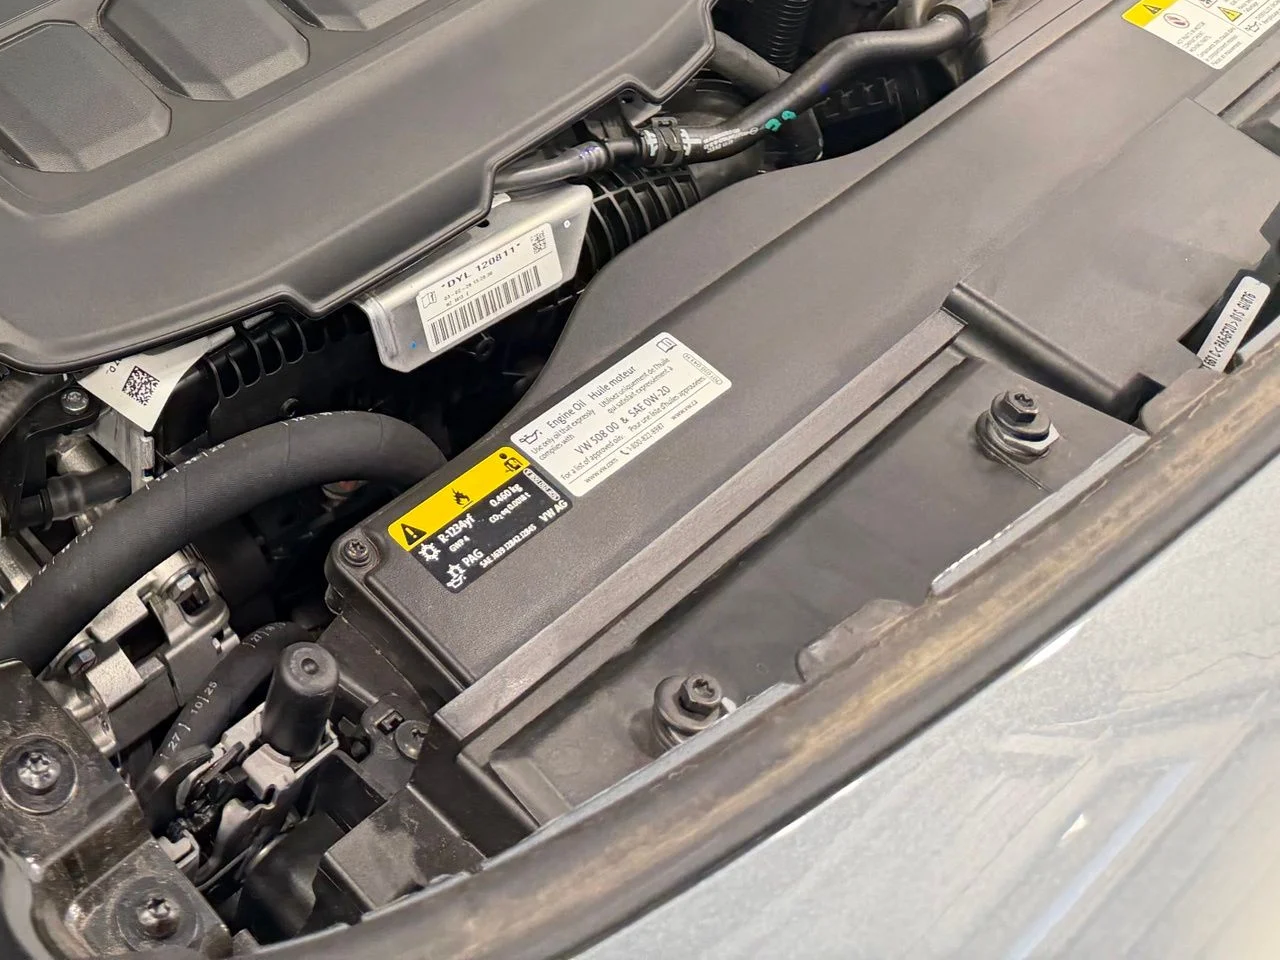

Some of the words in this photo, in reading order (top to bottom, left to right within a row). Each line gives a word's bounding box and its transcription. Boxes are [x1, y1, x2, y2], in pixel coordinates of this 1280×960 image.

[588, 384, 610, 400] Huile
[609, 365, 636, 387] moteur
[599, 392, 618, 408] Utilisez
[619, 372, 648, 398] uniquement
[547, 408, 575, 429] Engine
[572, 399, 587, 411] Oil
[616, 392, 637, 409] satisfait
[531, 445, 544, 455] Use
[542, 437, 554, 449] only
[559, 423, 572, 435] that
[571, 408, 596, 429] expressly
[574, 440, 593, 455] VW
[591, 429, 609, 444] 508
[606, 422, 619, 434] 00
[628, 403, 646, 418] SAE
[642, 385, 671, 407] 0W-20
[628, 423, 640, 432] Pour
[648, 408, 662, 418] liste
[539, 442, 563, 461] complies
[561, 434, 575, 446] with
[560, 472, 571, 481] For
[575, 461, 586, 471] list
[589, 441, 615, 464] approved
[437, 513, 475, 544] R-1234yf
[489, 486, 513, 507] 0.460
[511, 483, 523, 497] kg
[449, 538, 465, 552] GWP
[480, 556, 494, 568] SAE
[538, 510, 556, 523] VW
[554, 499, 568, 514] AG
[462, 548, 484, 567] PAG
